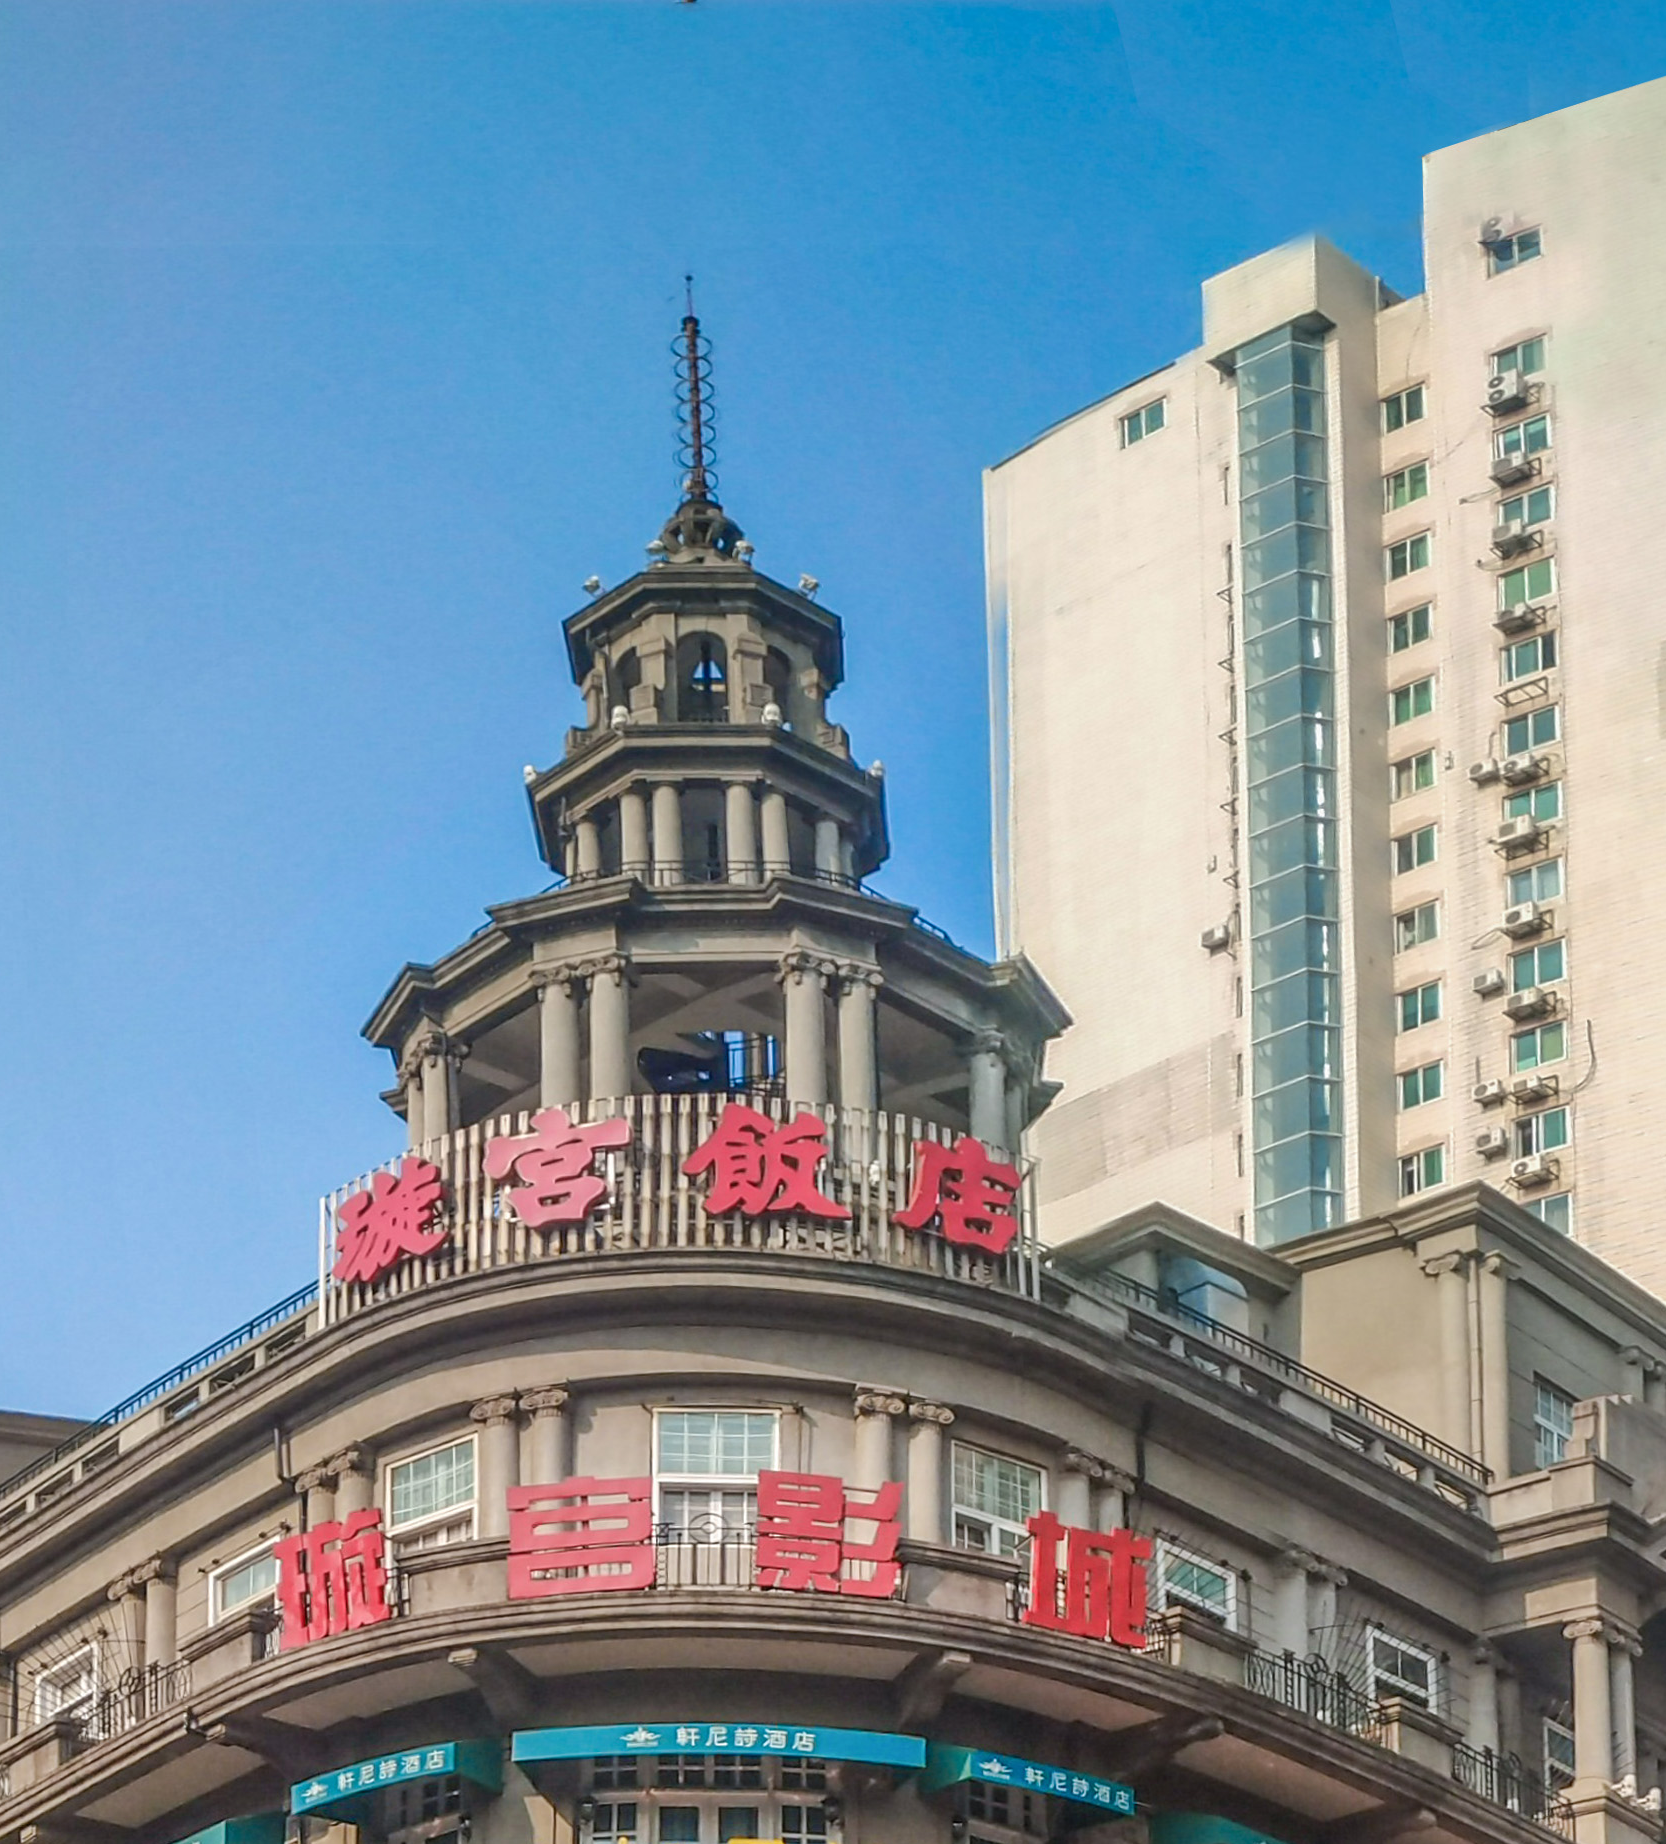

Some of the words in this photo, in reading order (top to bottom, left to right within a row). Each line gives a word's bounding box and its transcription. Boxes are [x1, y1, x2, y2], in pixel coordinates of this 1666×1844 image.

[677, 1727, 816, 1752] 軒尼詩酒店
[337, 1748, 446, 1792] 軒尼詩酒店
[1024, 1765, 1130, 1810] 軒尼詩酒店
